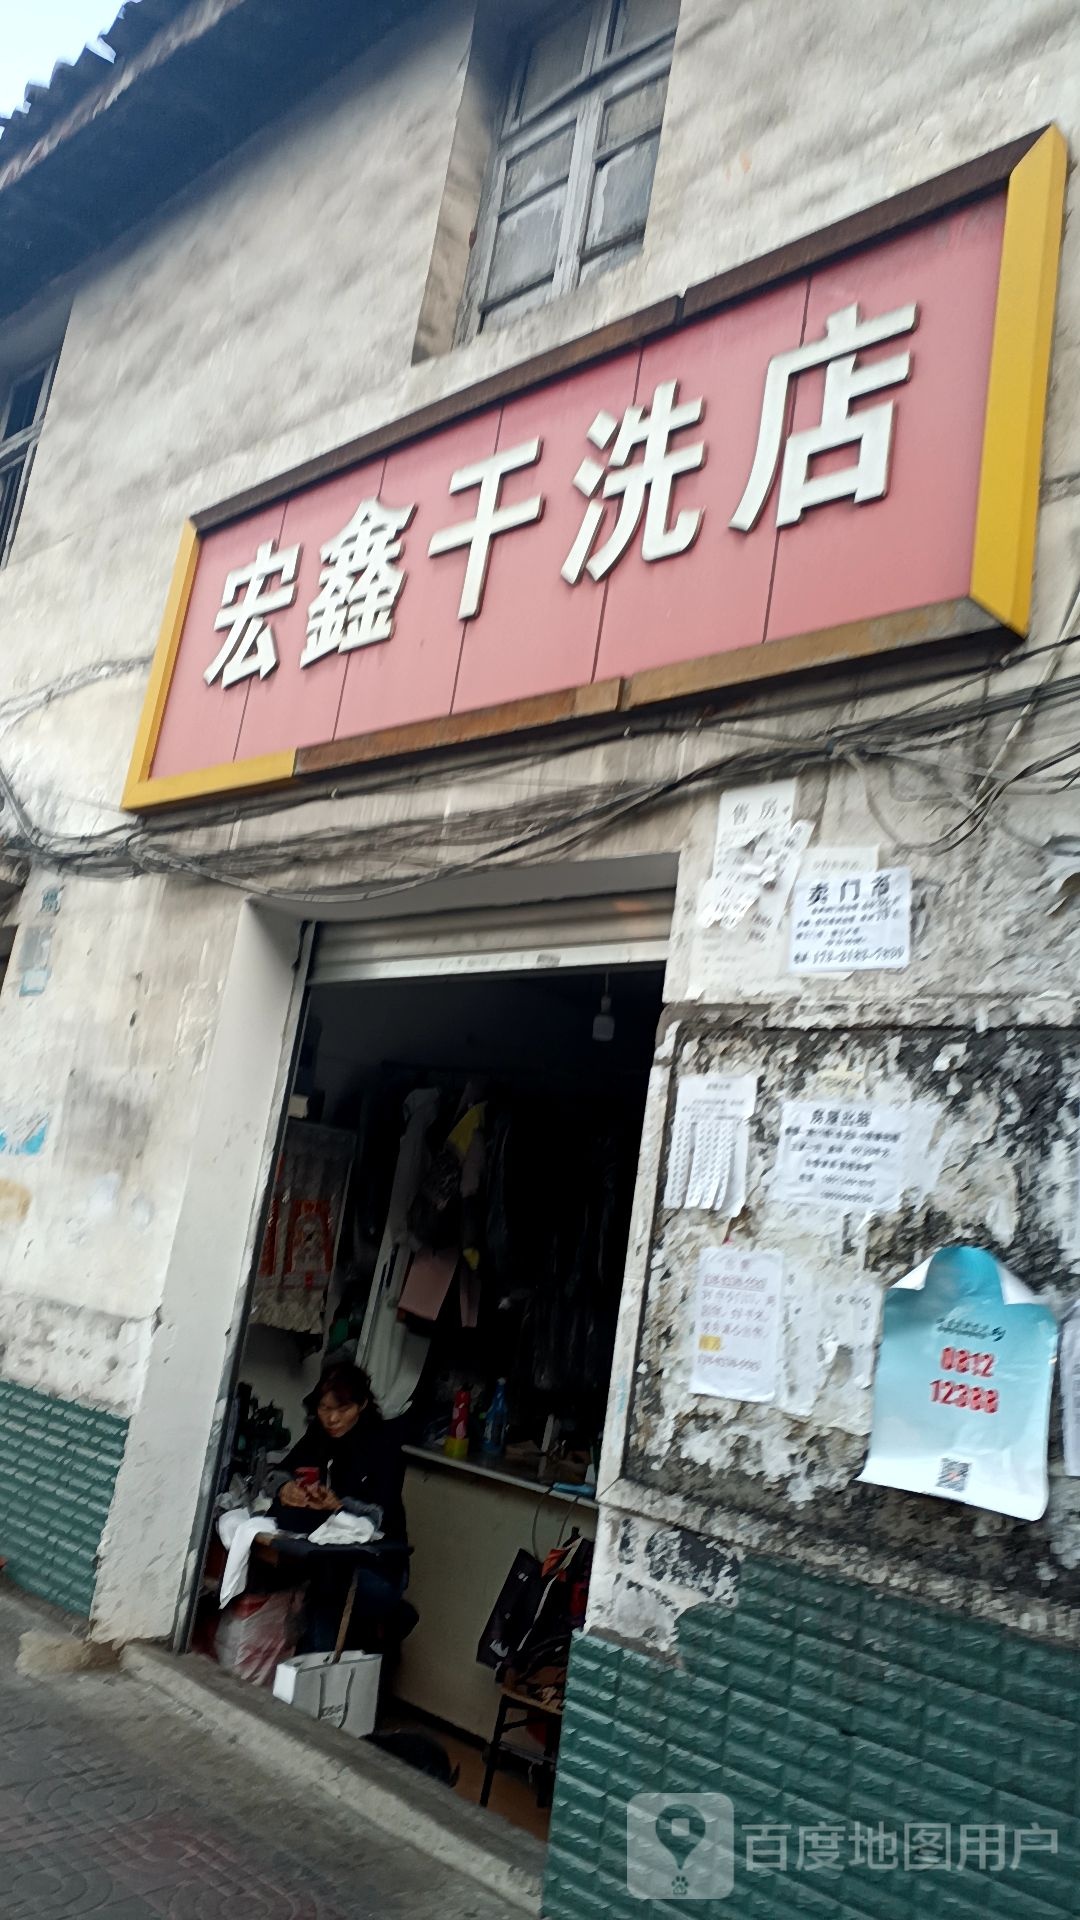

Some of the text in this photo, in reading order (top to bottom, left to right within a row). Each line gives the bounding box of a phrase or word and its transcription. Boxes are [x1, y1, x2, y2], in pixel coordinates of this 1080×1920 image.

[203, 302, 918, 689] 宏鑫干洗店
[941, 1346, 995, 1377] 0812
